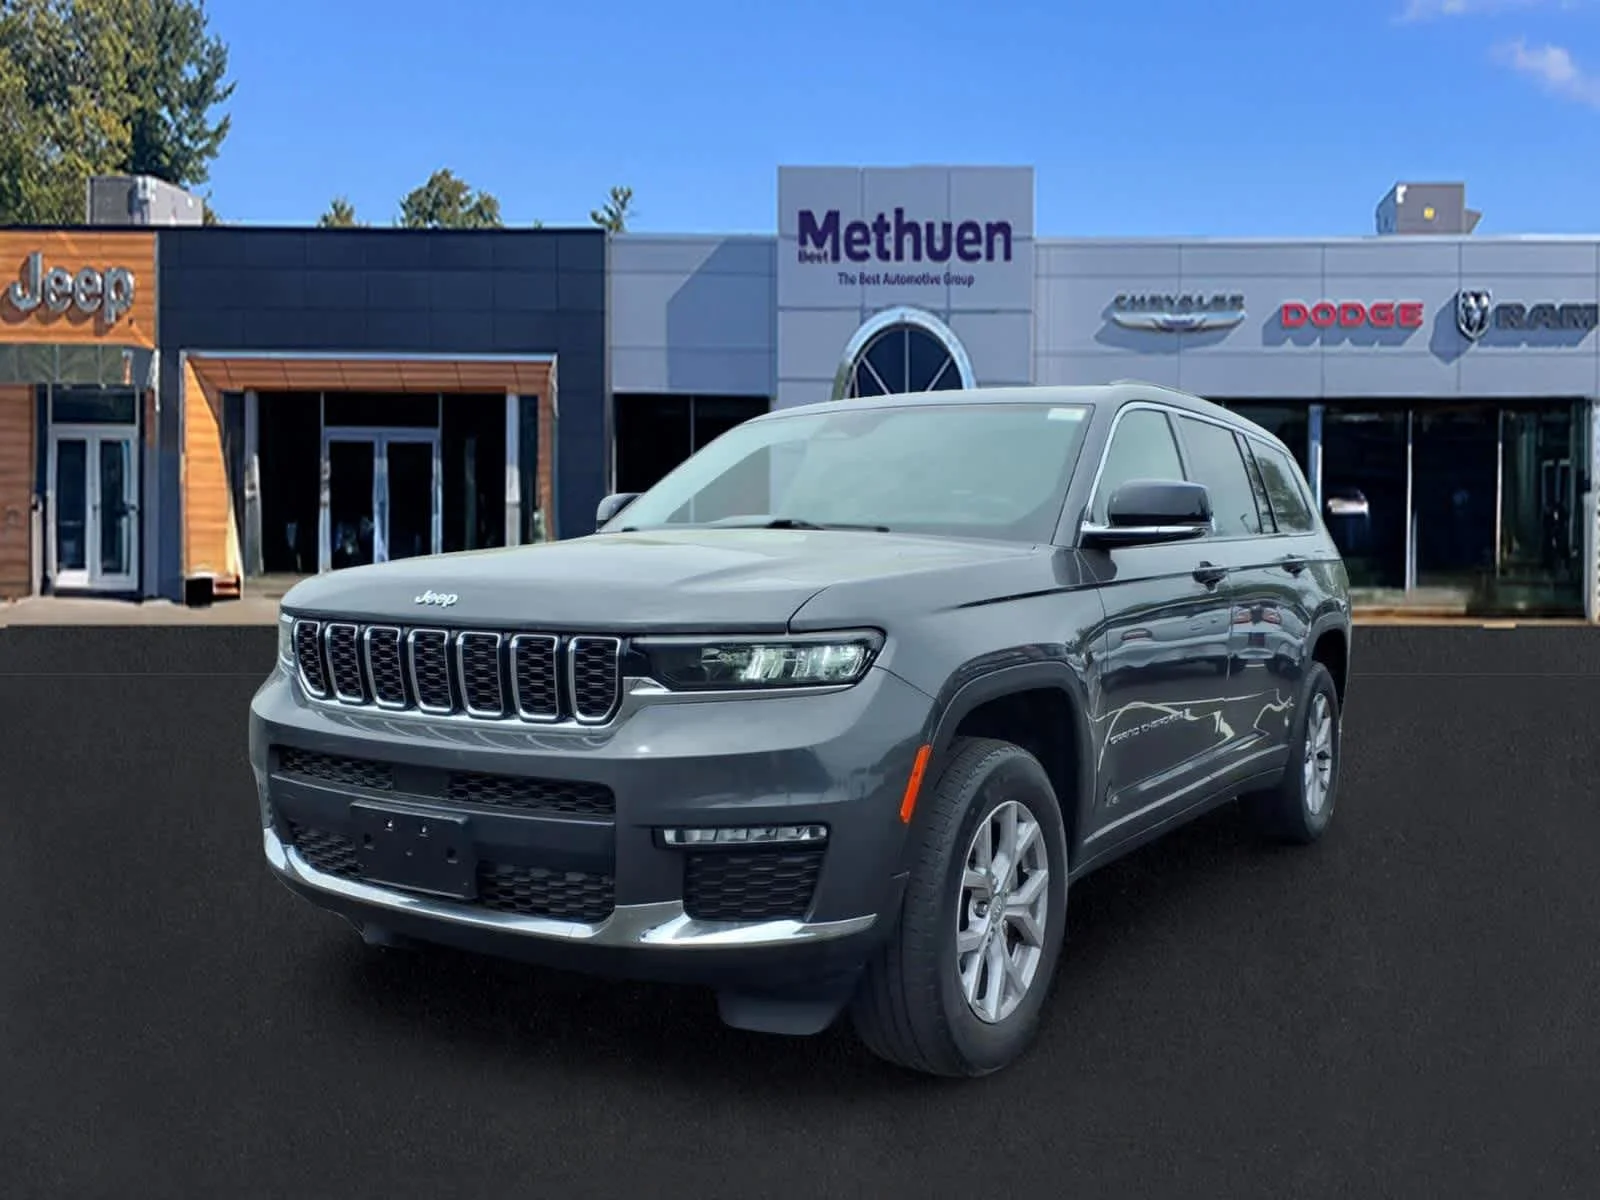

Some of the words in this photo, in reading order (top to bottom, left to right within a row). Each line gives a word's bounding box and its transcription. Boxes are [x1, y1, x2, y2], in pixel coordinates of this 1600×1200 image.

[798, 207, 1012, 263] Methuen
[9, 251, 135, 324] Jeep
[838, 272, 857, 285] The
[859, 272, 881, 285] Best
[883, 272, 941, 285] Automotive
[943, 272, 975, 288] Group
[1114, 294, 1245, 310] CHRYSLER
[1281, 302, 1423, 328] DODGE
[1495, 303, 1598, 328] RAM
[415, 590, 458, 608] Jeep
